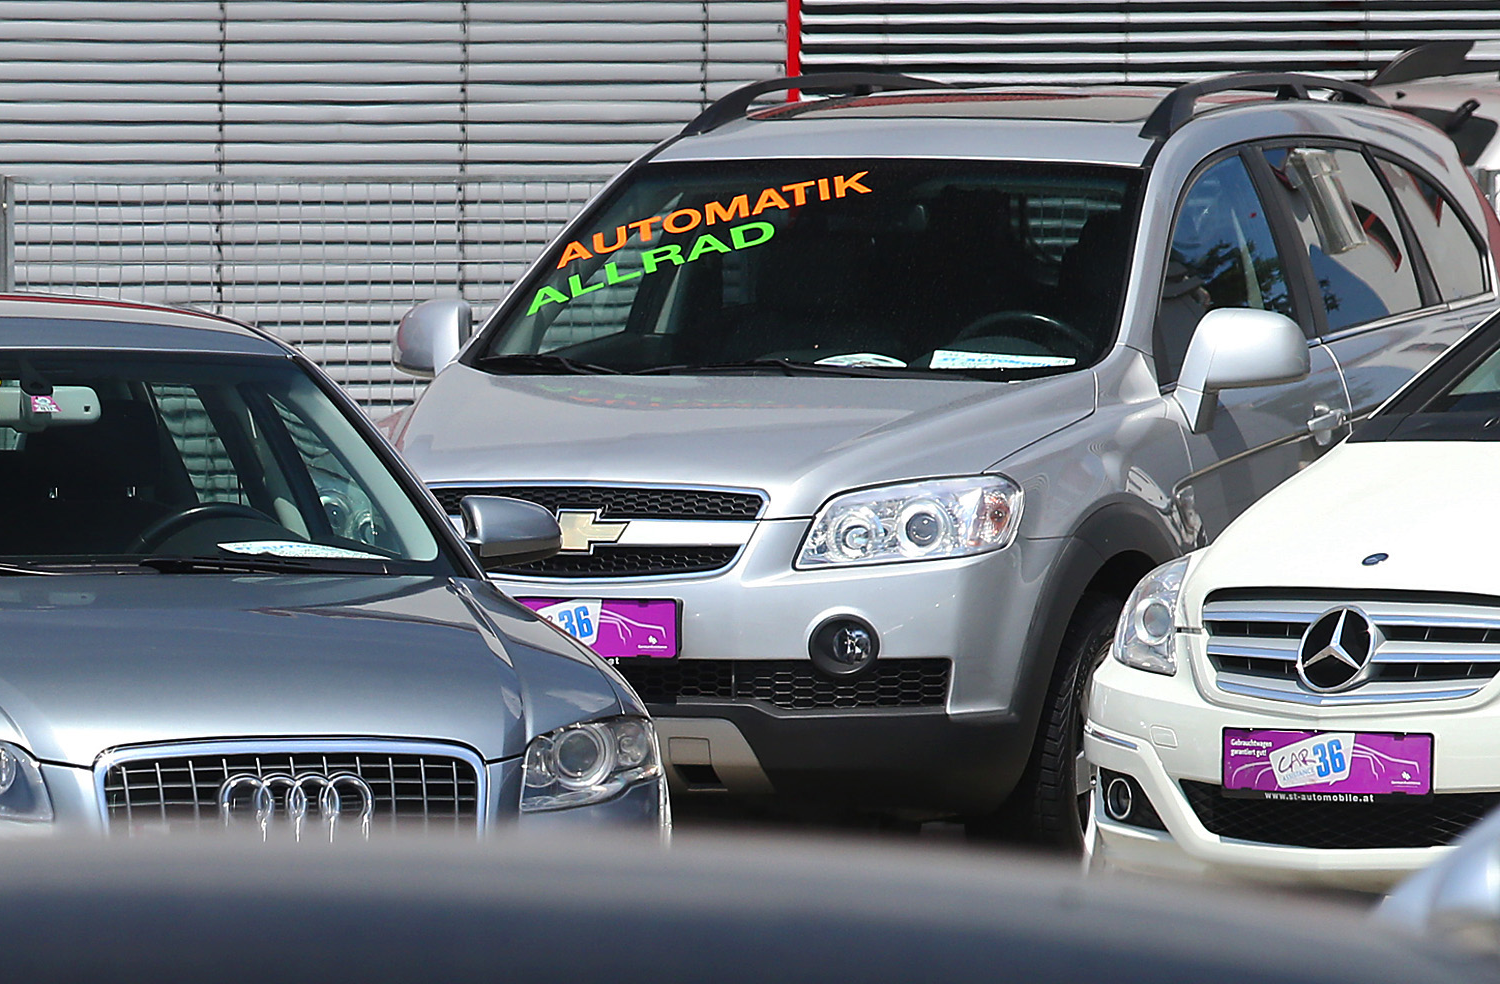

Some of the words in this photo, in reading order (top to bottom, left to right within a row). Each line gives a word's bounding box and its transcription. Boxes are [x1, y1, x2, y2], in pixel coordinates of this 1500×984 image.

[557, 170, 873, 269] AUTOMATIK
[525, 221, 775, 316] ALLRAD
[1278, 748, 1317, 773] CAR
[1312, 739, 1346, 778] 36
[1264, 791, 1375, 803] www.st-automobile.at
